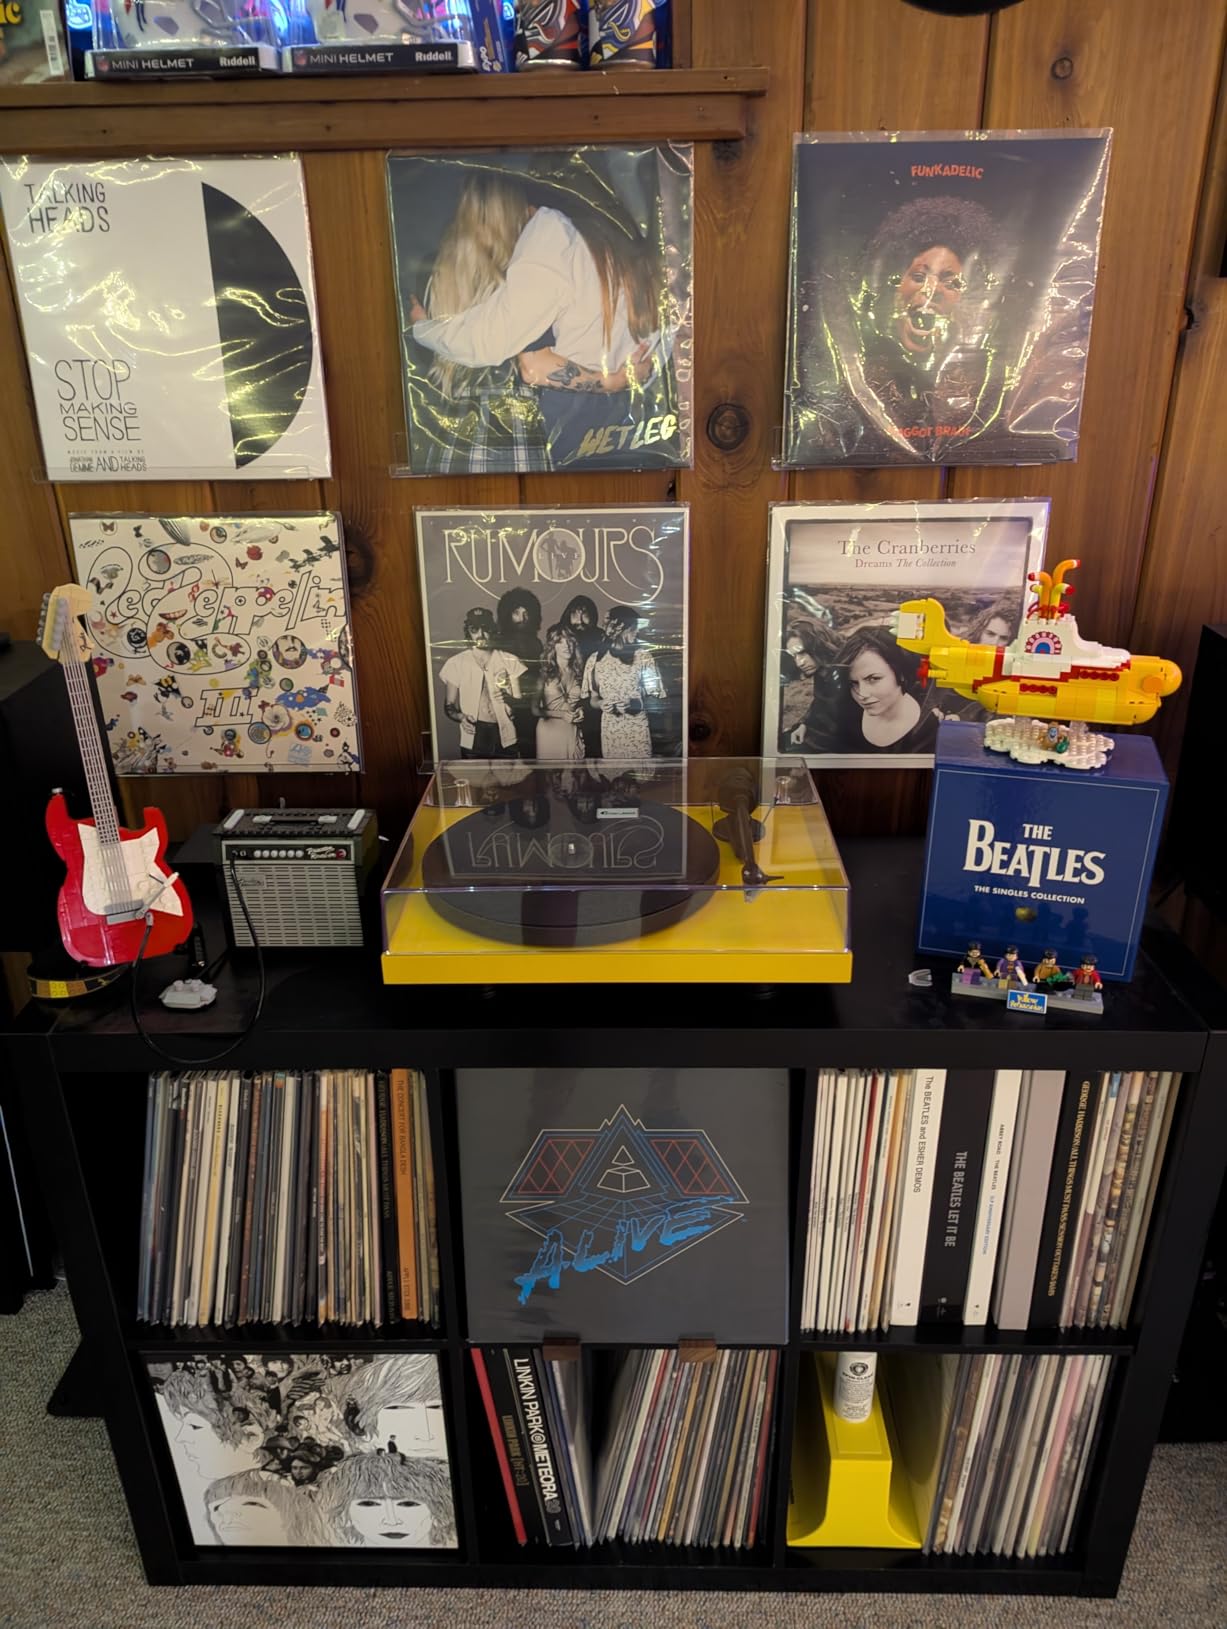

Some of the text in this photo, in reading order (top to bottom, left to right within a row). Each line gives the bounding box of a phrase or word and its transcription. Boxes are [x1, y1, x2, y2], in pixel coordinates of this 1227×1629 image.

[111, 58, 194, 70] MINI HELMET
[219, 55, 256, 67] Riddell
[310, 52, 394, 64] MINI HELMET
[415, 51, 452, 62] Riddell
[910, 164, 984, 179] FUNKADELIC
[25, 182, 106, 204] TALKING
[29, 206, 110, 233] HEADS
[54, 359, 131, 401] STOP
[60, 401, 138, 416] MAKING
[63, 415, 142, 441] SENSE
[577, 414, 677, 459] WET LEG
[838, 539, 976, 555] The Cranberries
[443, 526, 664, 606] RUMOURS
[855, 558, 957, 568] Dreams The Collection
[1022, 823, 1053, 841] THE
[963, 819, 1106, 888] BEATLES
[974, 885, 1085, 905] THE SINGLES COLLECTION
[1078, 1080, 1091, 1110] GEORGE
[913, 1076, 934, 1193] The BEATLES and ESHER DEMOS
[954, 1151, 968, 1168] THE
[949, 1171, 966, 1207] BEATLES
[947, 1210, 960, 1224] LET
[514, 1195, 734, 1306] ALIVE
[944, 1236, 957, 1247] BE
[513, 1358, 537, 1400] LINKIN
[523, 1401, 544, 1435] PARK
[532, 1443, 558, 1501] METEORA
